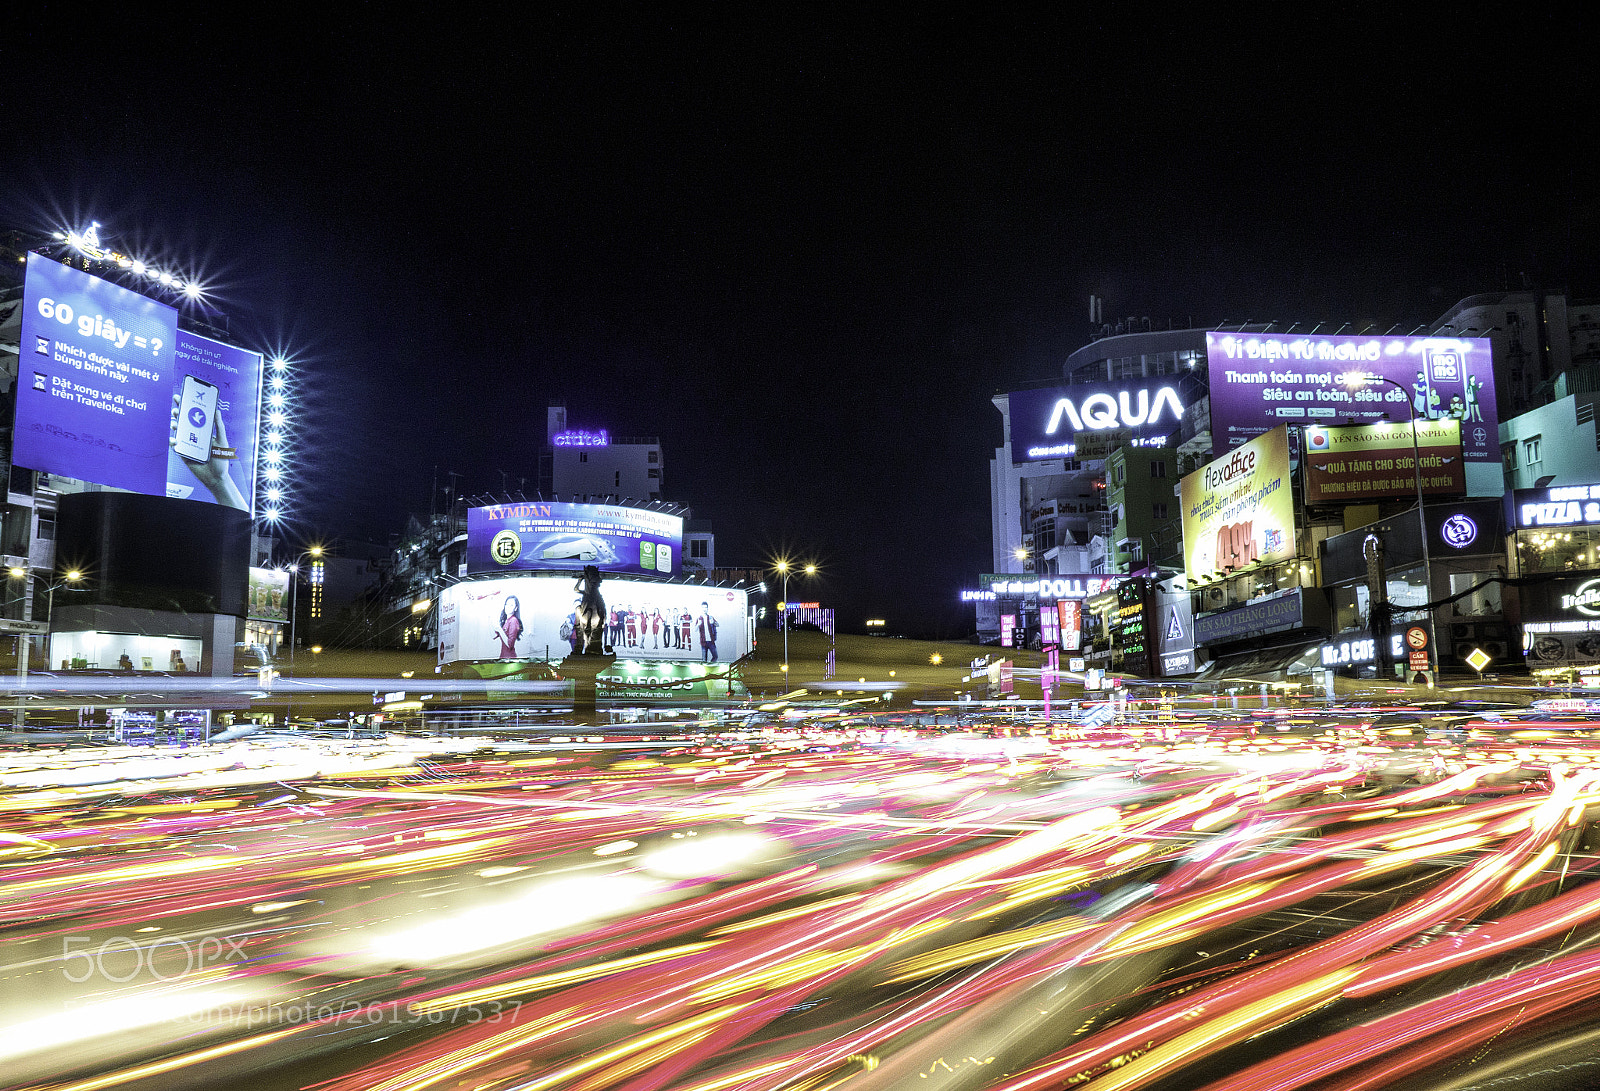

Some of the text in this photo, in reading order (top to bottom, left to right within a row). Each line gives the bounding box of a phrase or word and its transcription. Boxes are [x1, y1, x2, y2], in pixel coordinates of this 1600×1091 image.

[38, 297, 73, 324] 60
[77, 314, 131, 348] giây
[151, 338, 163, 356] ?
[55, 341, 159, 381] Nhích được vài mét ở
[204, 348, 213, 357] tin
[1222, 338, 1380, 363] VÍ ĐIỆN TỬ MOMO
[1433, 355, 1455, 366] mo
[54, 352, 82, 369] bùng
[109, 370, 129, 383] này.
[1225, 371, 1267, 384] Thanh
[1270, 370, 1302, 384] toán
[1305, 372, 1331, 387] mọi
[1434, 366, 1457, 377] mo
[52, 376, 147, 411] Đặt xong vé đi chơi
[52, 387, 126, 415] trên Traveloka.
[1263, 388, 1292, 401] Siêu
[1295, 391, 1314, 401] an
[1316, 388, 1352, 403] toàn,
[1355, 389, 1383, 402] siêu
[1045, 386, 1184, 435] AQUA
[554, 429, 607, 446] cititel
[1332, 427, 1448, 444] YẾN SÀO SÀI GÒN ANPHA
[1205, 450, 1255, 492] flexoffice
[1327, 453, 1442, 475] QUÀ TẶNG CHO SỨC KHỎE
[1320, 482, 1345, 494] THƯƠNG
[1346, 480, 1361, 493] HIỆU
[1373, 479, 1390, 492] ĐƯỢC
[1391, 475, 1405, 489] BẢO
[1405, 477, 1414, 490] HỘ
[488, 505, 672, 526] KYMDAN www.kymdan.com
[1522, 501, 1582, 526] PIZZA
[1217, 520, 1258, 575] 49%
[1039, 579, 1086, 598] DOLL
[1197, 599, 1297, 632] YẾN SÀO THĂNG LONG
[1322, 642, 1350, 664] Mr.8
